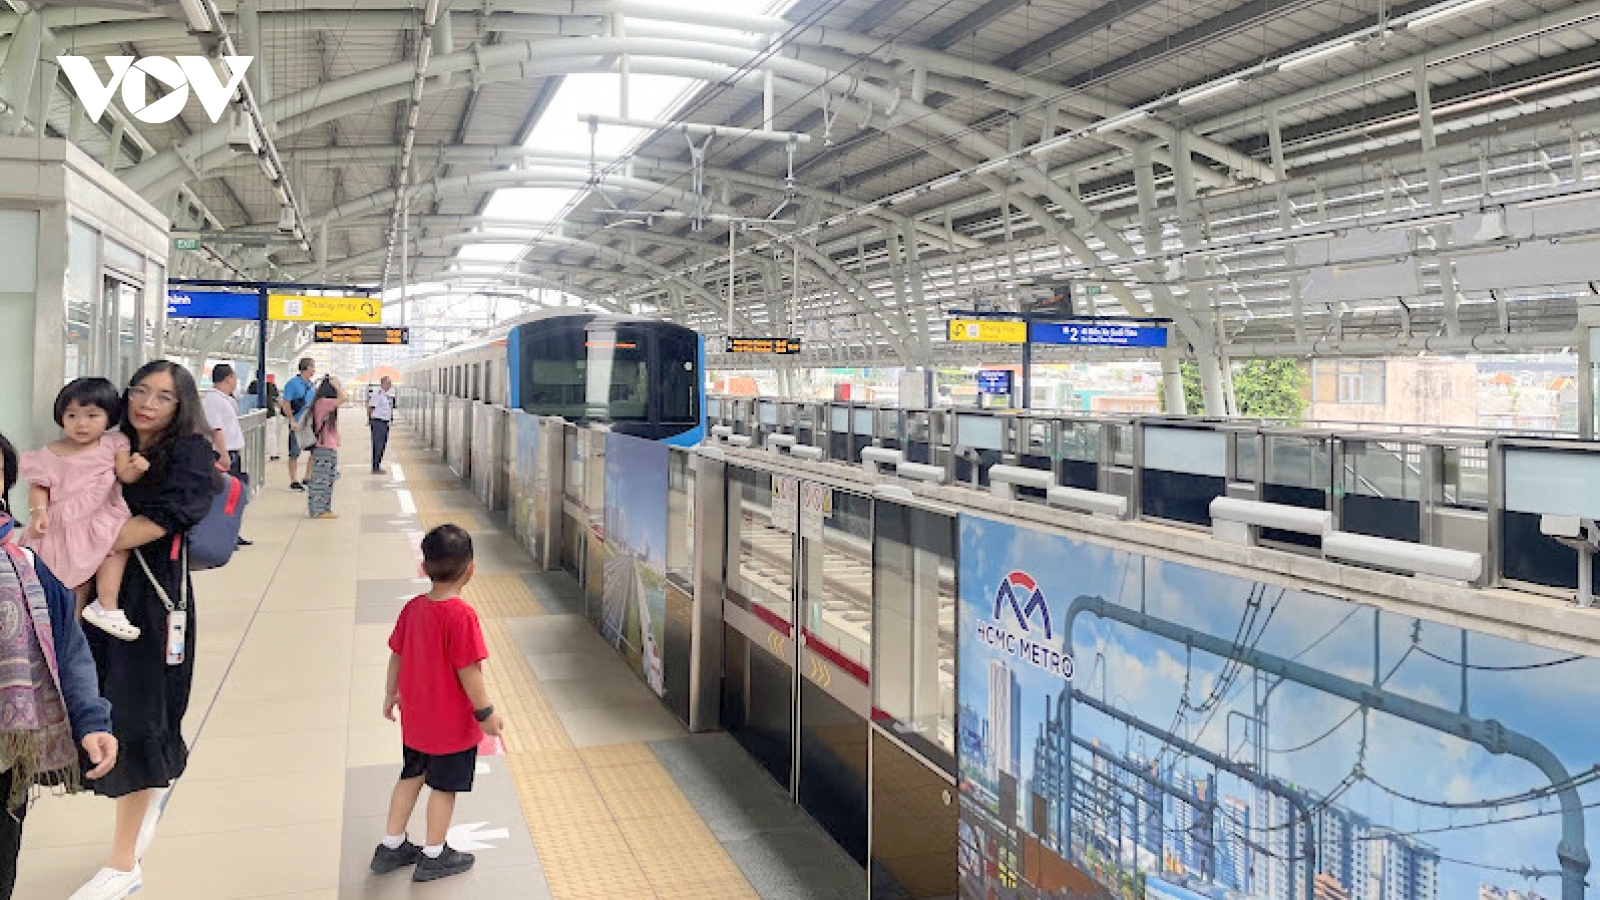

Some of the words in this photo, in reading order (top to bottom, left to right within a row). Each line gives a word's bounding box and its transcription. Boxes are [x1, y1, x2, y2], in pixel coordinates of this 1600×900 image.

[178, 239, 195, 249] EXIT
[1069, 327, 1079, 341] 2
[977, 623, 1016, 654] HCMC
[1019, 638, 1074, 678] METRO
